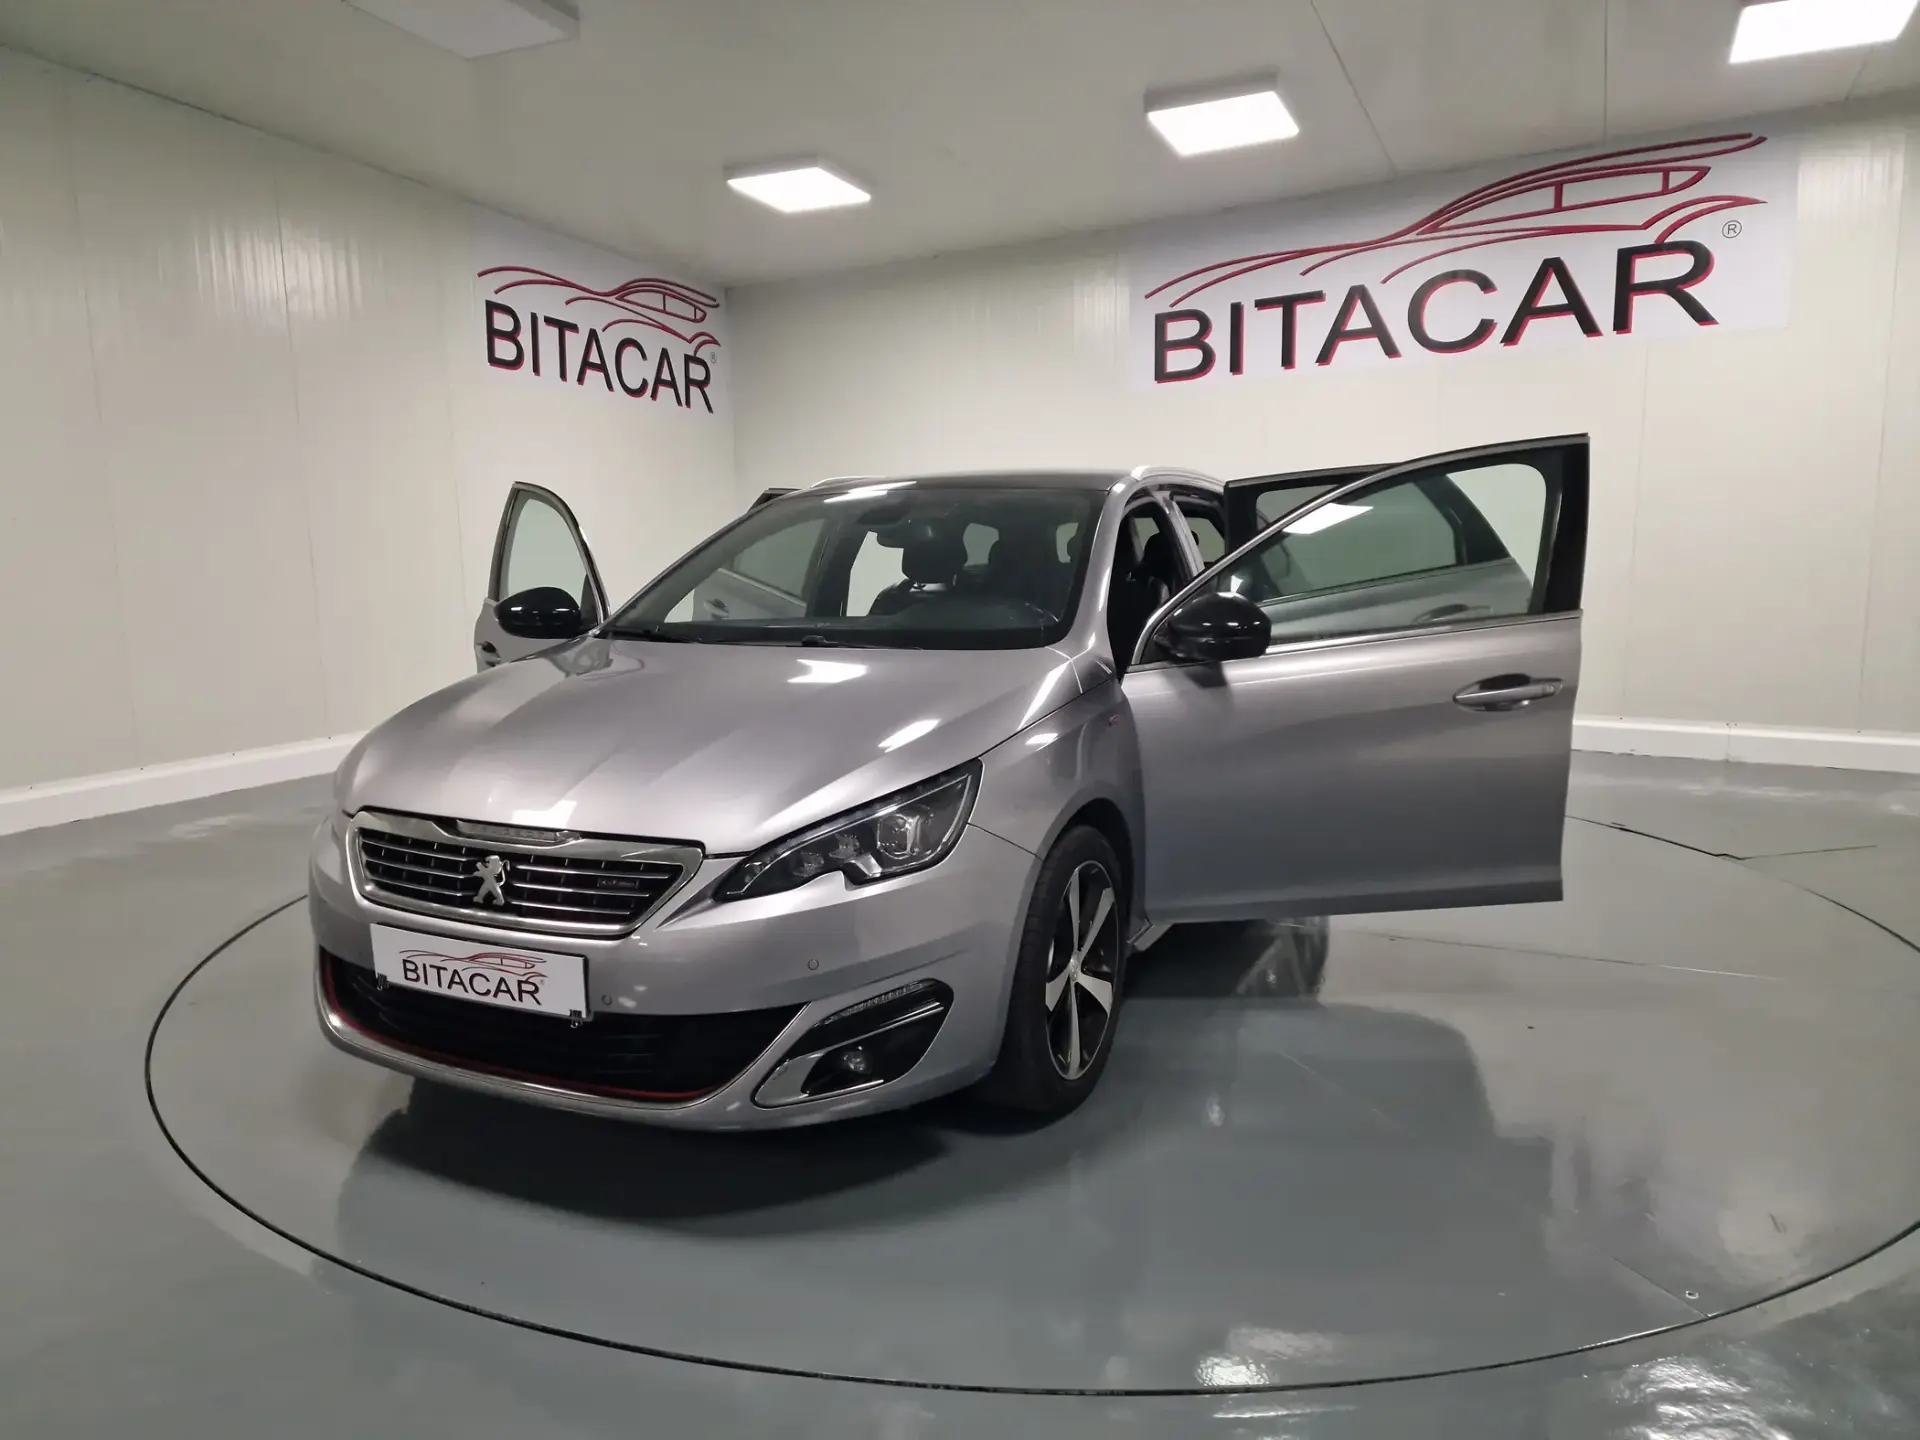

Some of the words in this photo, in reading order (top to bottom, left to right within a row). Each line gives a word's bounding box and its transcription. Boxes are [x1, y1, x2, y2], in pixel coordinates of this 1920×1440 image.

[485, 299, 714, 414] BITACAR
[1154, 240, 1719, 384] BITACAR
[402, 958, 542, 1006] BITACAR
